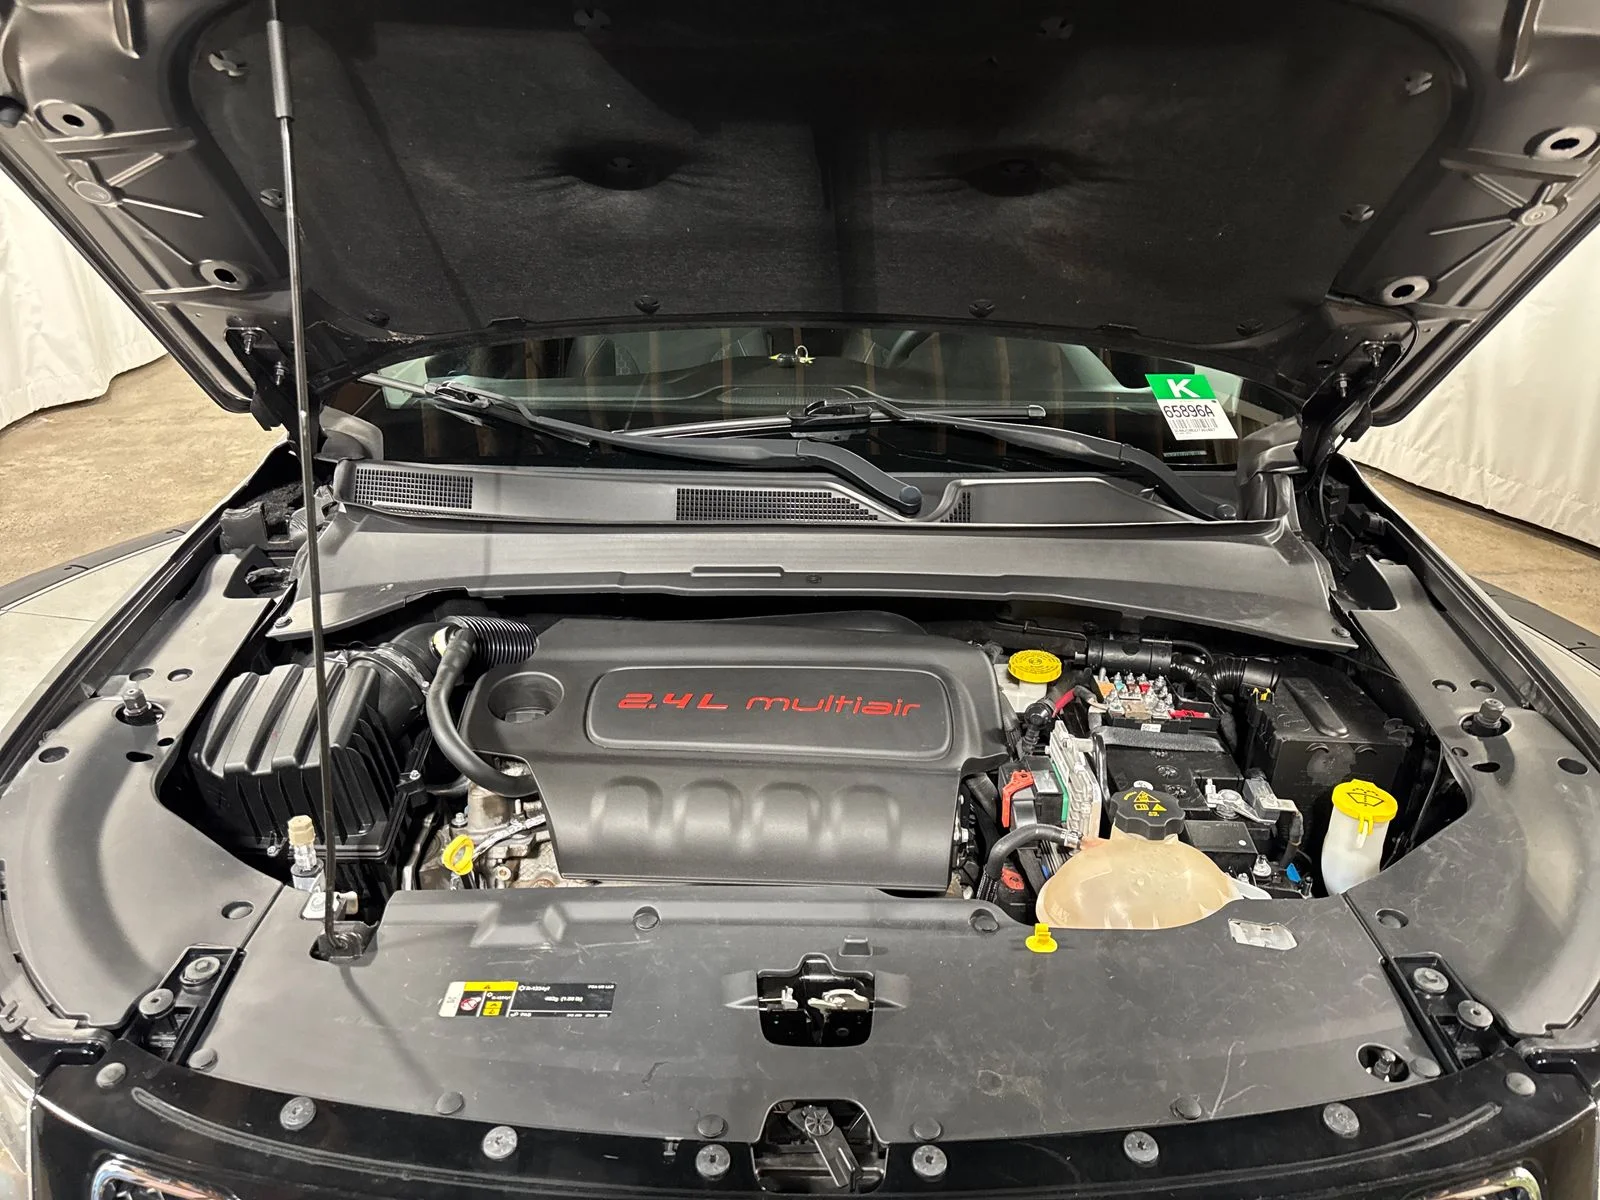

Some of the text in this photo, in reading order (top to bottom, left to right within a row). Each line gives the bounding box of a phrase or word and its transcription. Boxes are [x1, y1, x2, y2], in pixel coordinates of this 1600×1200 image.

[1167, 379, 1201, 398] K
[1163, 404, 1215, 418] 65896A
[745, 694, 921, 717] multiair
